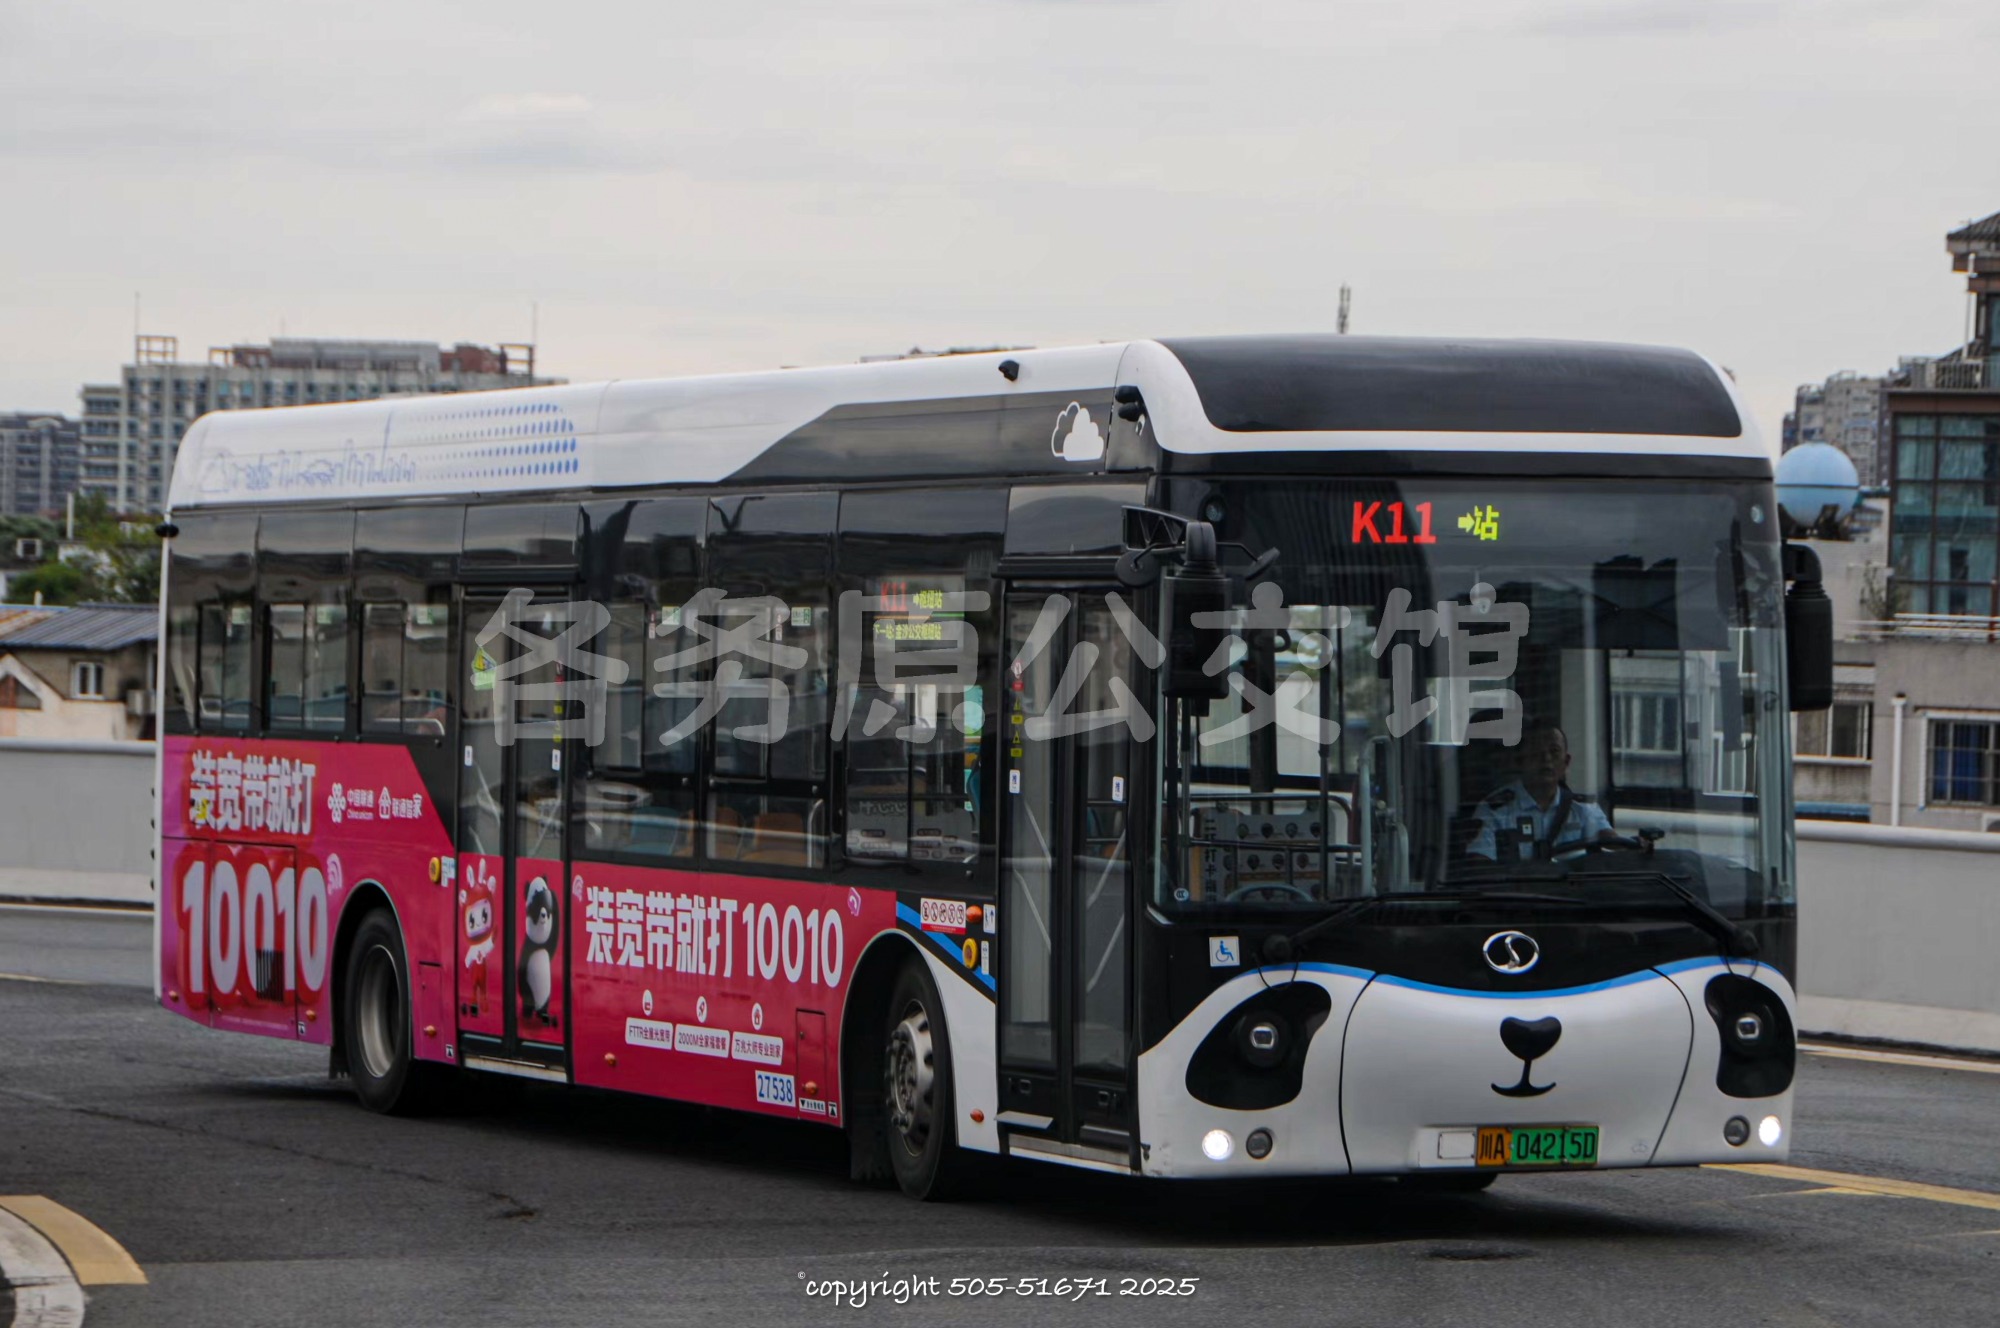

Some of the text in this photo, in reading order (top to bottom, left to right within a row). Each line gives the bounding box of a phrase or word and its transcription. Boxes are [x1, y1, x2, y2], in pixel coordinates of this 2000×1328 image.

[1352, 502, 1437, 543] K11
[1473, 505, 1499, 540] 站
[881, 581, 908, 612] K11
[190, 750, 316, 835] 装宽带就打
[182, 860, 328, 994] 10010
[757, 1074, 793, 1103] 27538
